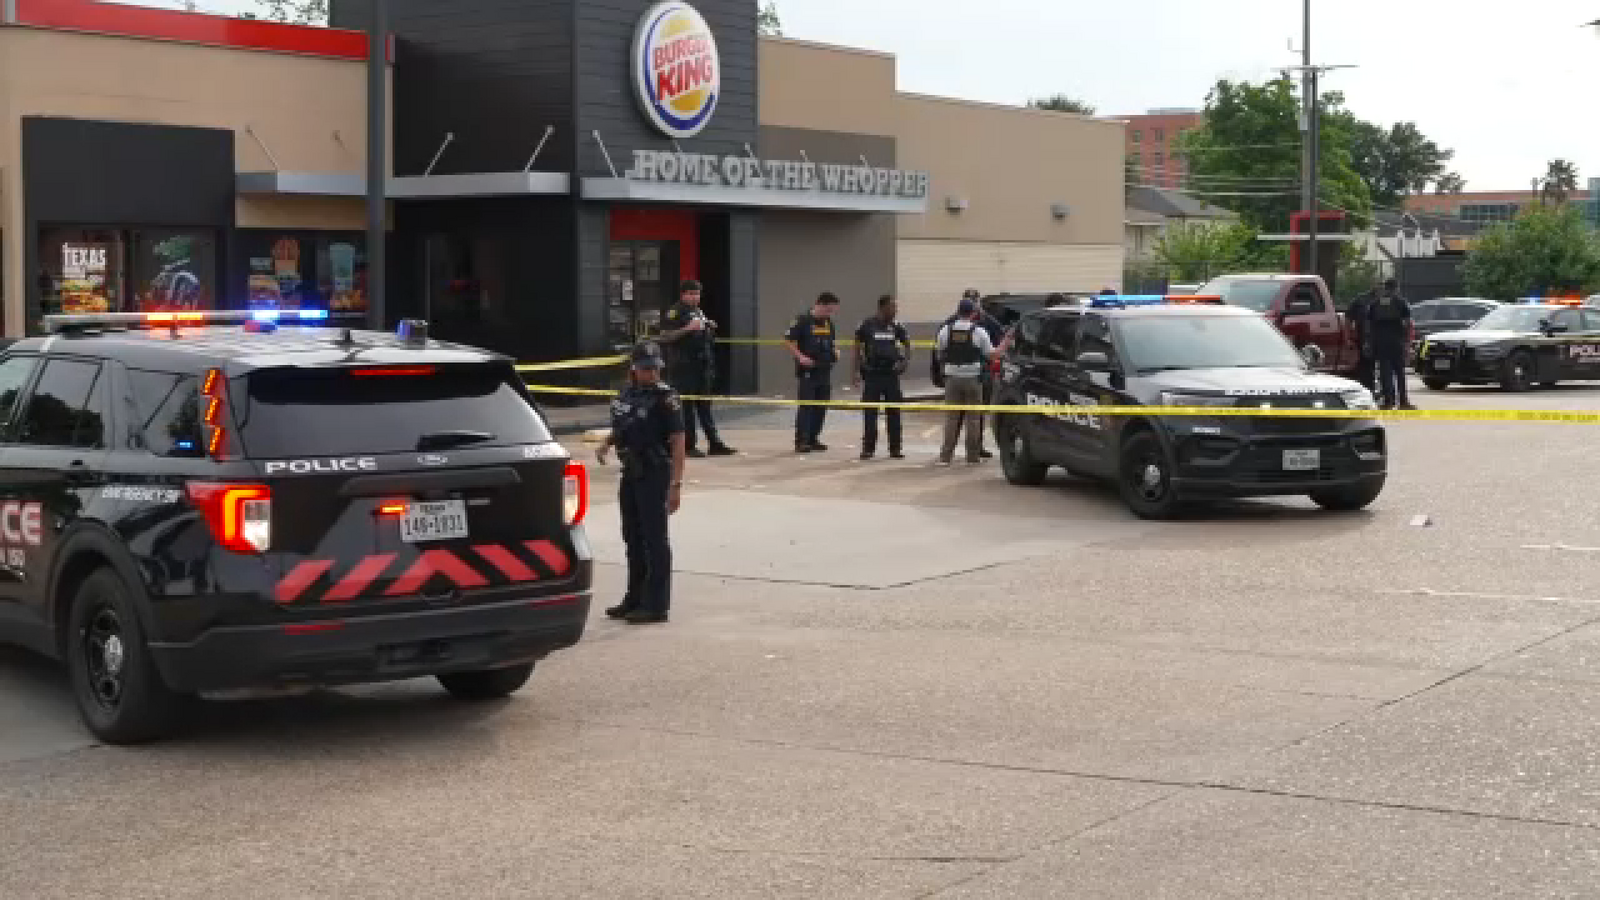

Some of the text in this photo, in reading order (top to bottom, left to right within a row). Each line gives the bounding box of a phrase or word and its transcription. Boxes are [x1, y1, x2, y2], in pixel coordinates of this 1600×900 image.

[656, 56, 713, 102] KING
[633, 150, 929, 197] HOME OF THE WHOPPER
[62, 242, 106, 266] TEXAS
[265, 456, 378, 474] POLICE
